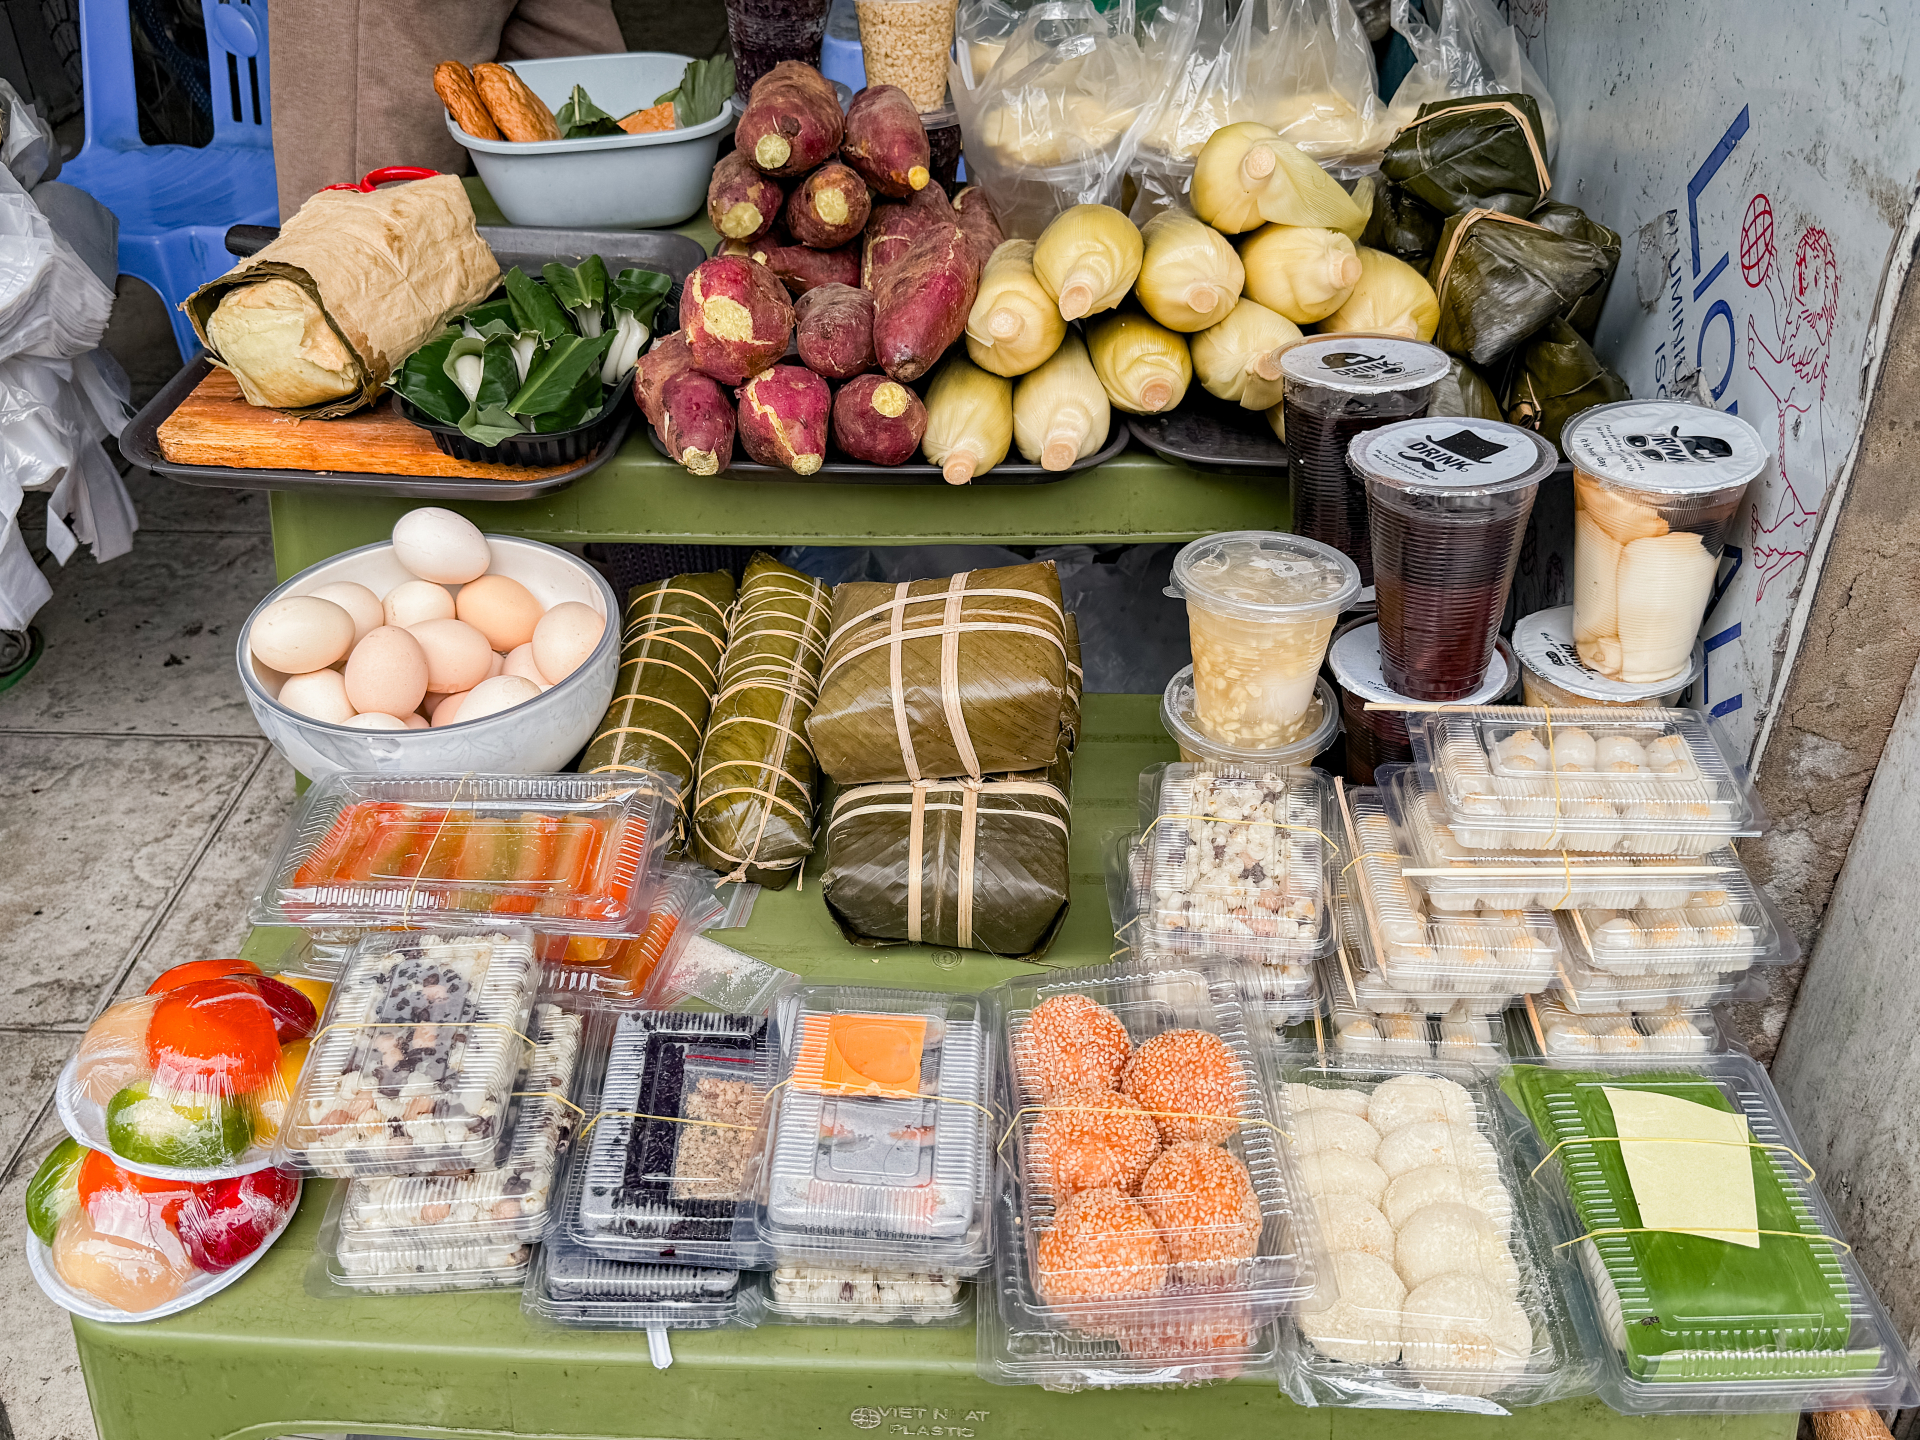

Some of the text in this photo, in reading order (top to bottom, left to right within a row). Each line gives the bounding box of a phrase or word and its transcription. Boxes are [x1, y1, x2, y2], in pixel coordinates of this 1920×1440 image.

[1687, 103, 1750, 414] LIO
[1332, 360, 1402, 376] DRINK
[1406, 441, 1475, 472] DRINK
[1646, 433, 1695, 464] RIN
[877, 1406, 990, 1422] VIET NAT
[889, 1424, 976, 1438] PLASTIC
